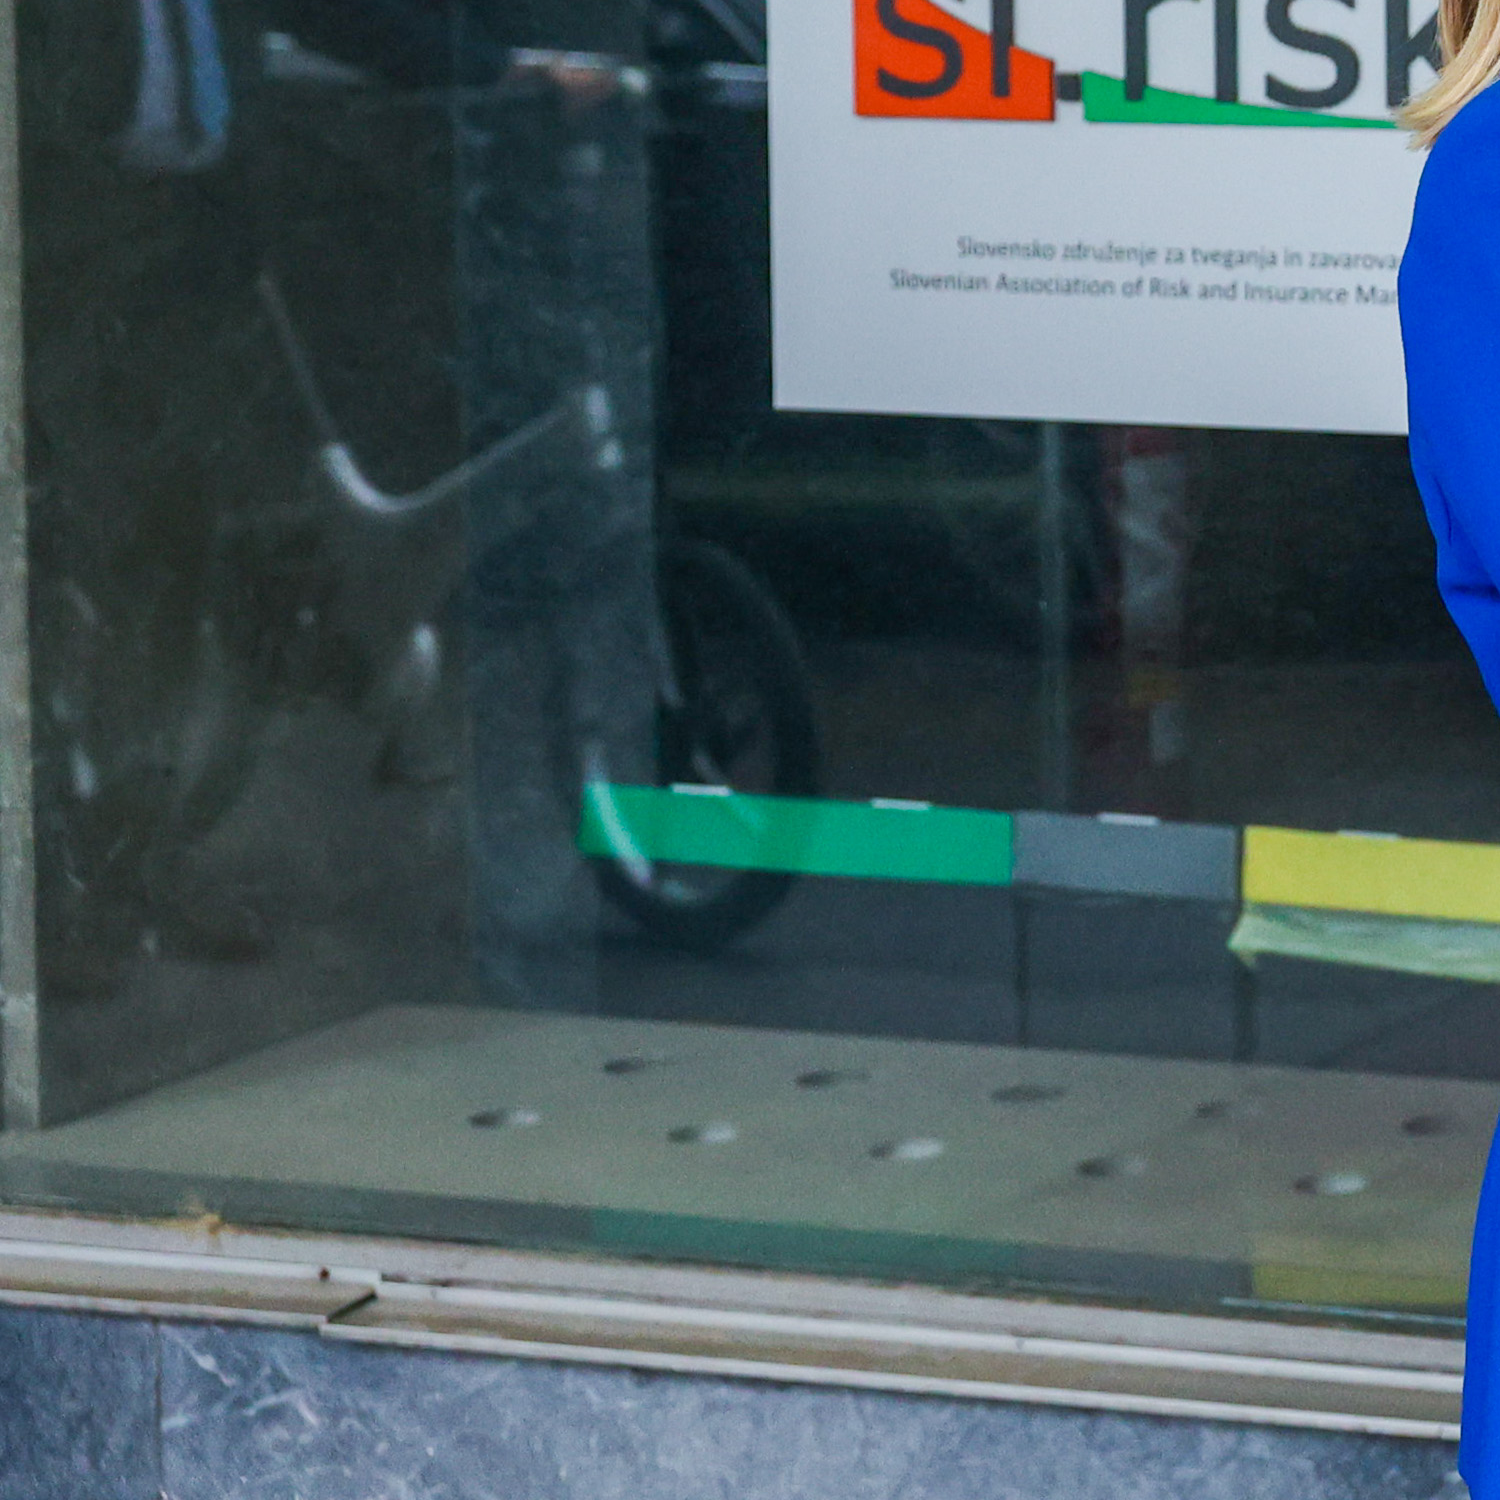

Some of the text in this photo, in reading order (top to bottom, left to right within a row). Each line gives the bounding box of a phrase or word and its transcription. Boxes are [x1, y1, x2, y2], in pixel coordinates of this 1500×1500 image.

[957, 236, 1397, 271] Slovensko združenje za tveganja in zavarova
[889, 269, 989, 291] Slovenian
[996, 273, 1115, 296] Association
[1121, 277, 1144, 298] of
[1149, 277, 1190, 298] Risk
[1198, 281, 1238, 301] and
[1244, 282, 1349, 304] Insurance
